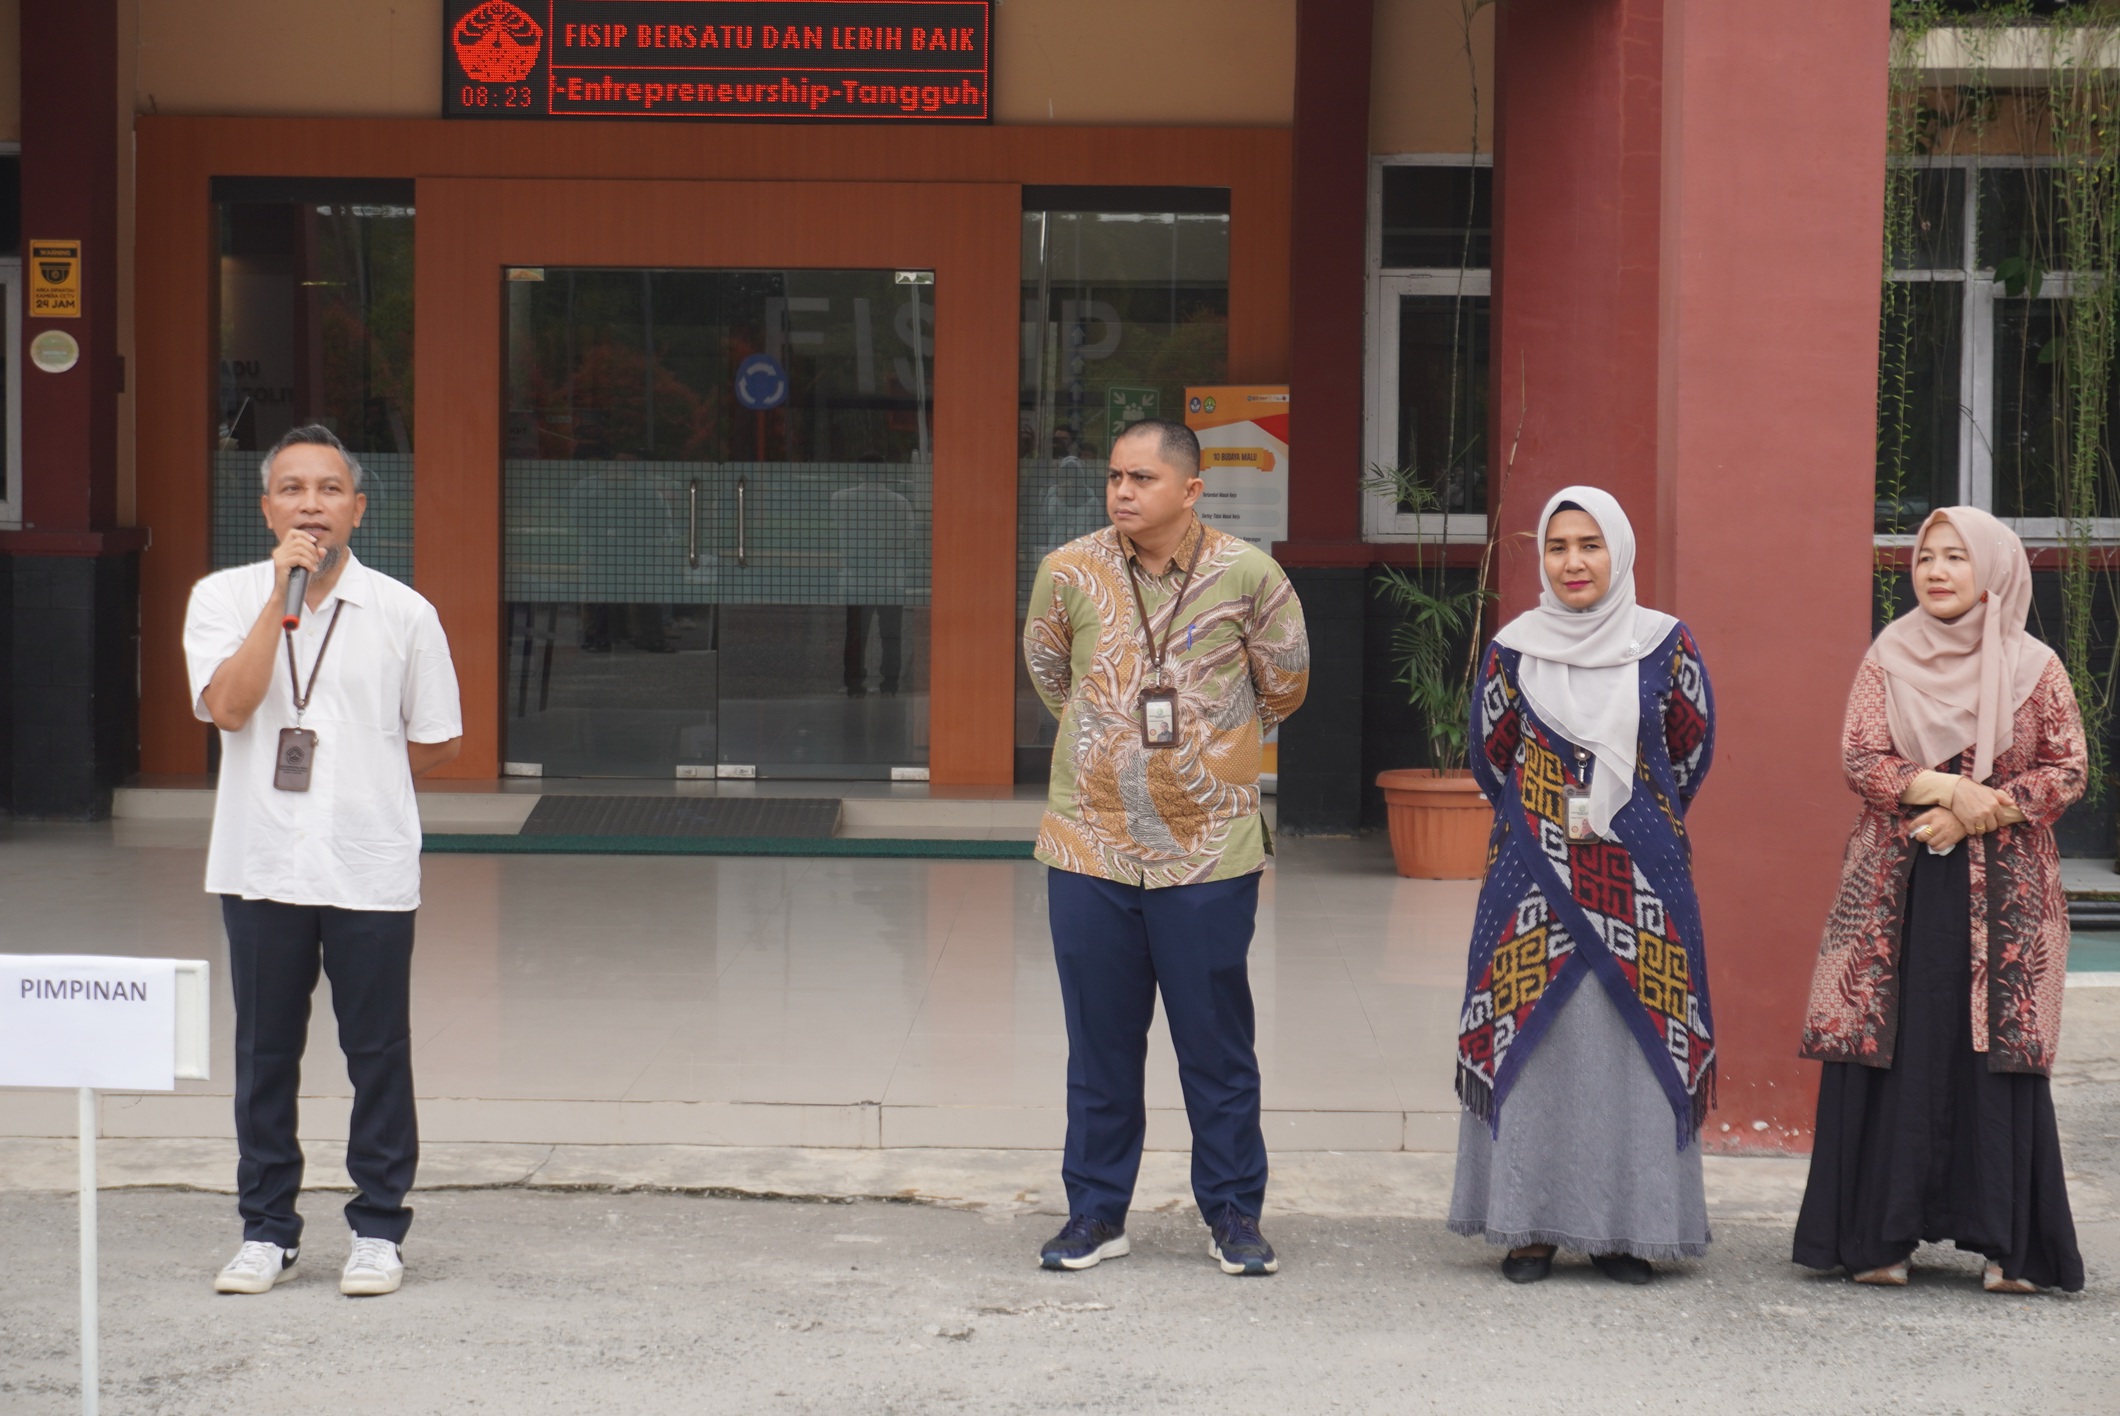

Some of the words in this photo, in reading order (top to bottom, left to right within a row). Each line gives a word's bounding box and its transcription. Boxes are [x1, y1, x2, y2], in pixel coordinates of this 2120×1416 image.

[566, 24, 628, 48] FISIP
[637, 25, 753, 49] BERSATU
[762, 26, 823, 50] DAN
[833, 27, 902, 50] LEBIH
[911, 27, 974, 51] BAIK
[461, 86, 532, 108] 08:23
[36, 299, 49, 309] 24
[51, 299, 76, 309] JAM
[1213, 453, 1221, 461] 10
[1221, 453, 1240, 461] BUDAYA
[1241, 453, 1258, 461] MALU
[21, 979, 147, 1001] PIMPINAN
